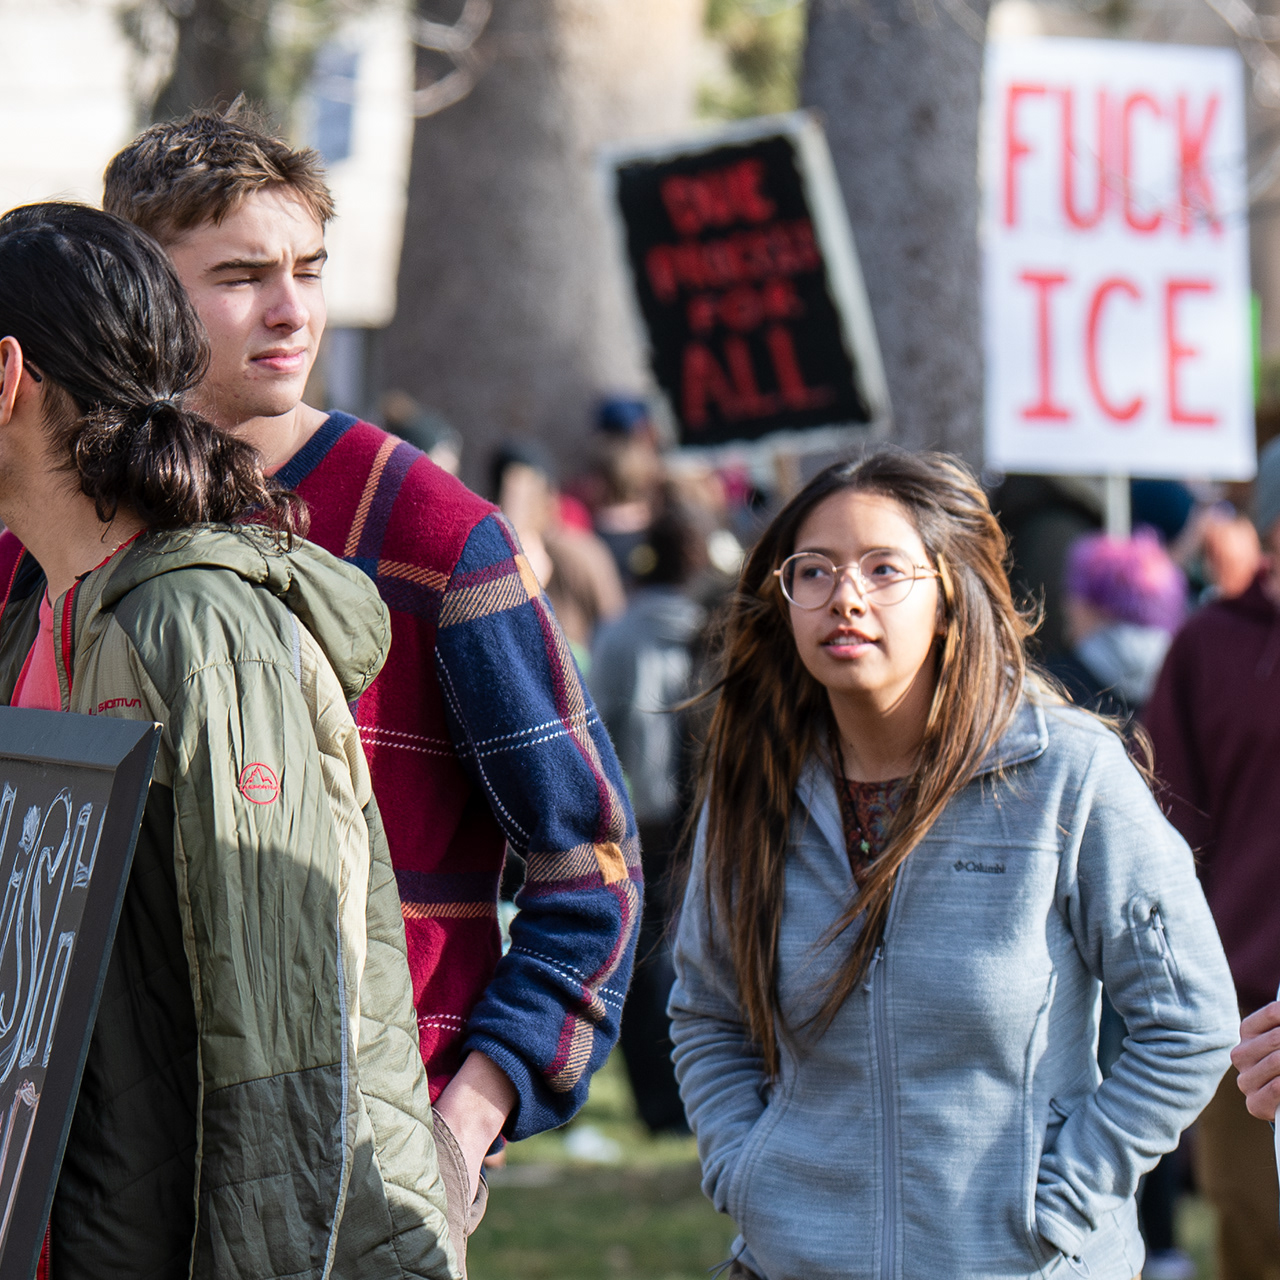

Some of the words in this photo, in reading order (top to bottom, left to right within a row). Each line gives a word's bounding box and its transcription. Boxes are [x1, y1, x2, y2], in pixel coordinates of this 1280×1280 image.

[1005, 84, 1224, 236] FUCK
[680, 326, 836, 430] ALL
[1020, 272, 1220, 425] ICE
[965, 861, 1006, 874] Columbi
